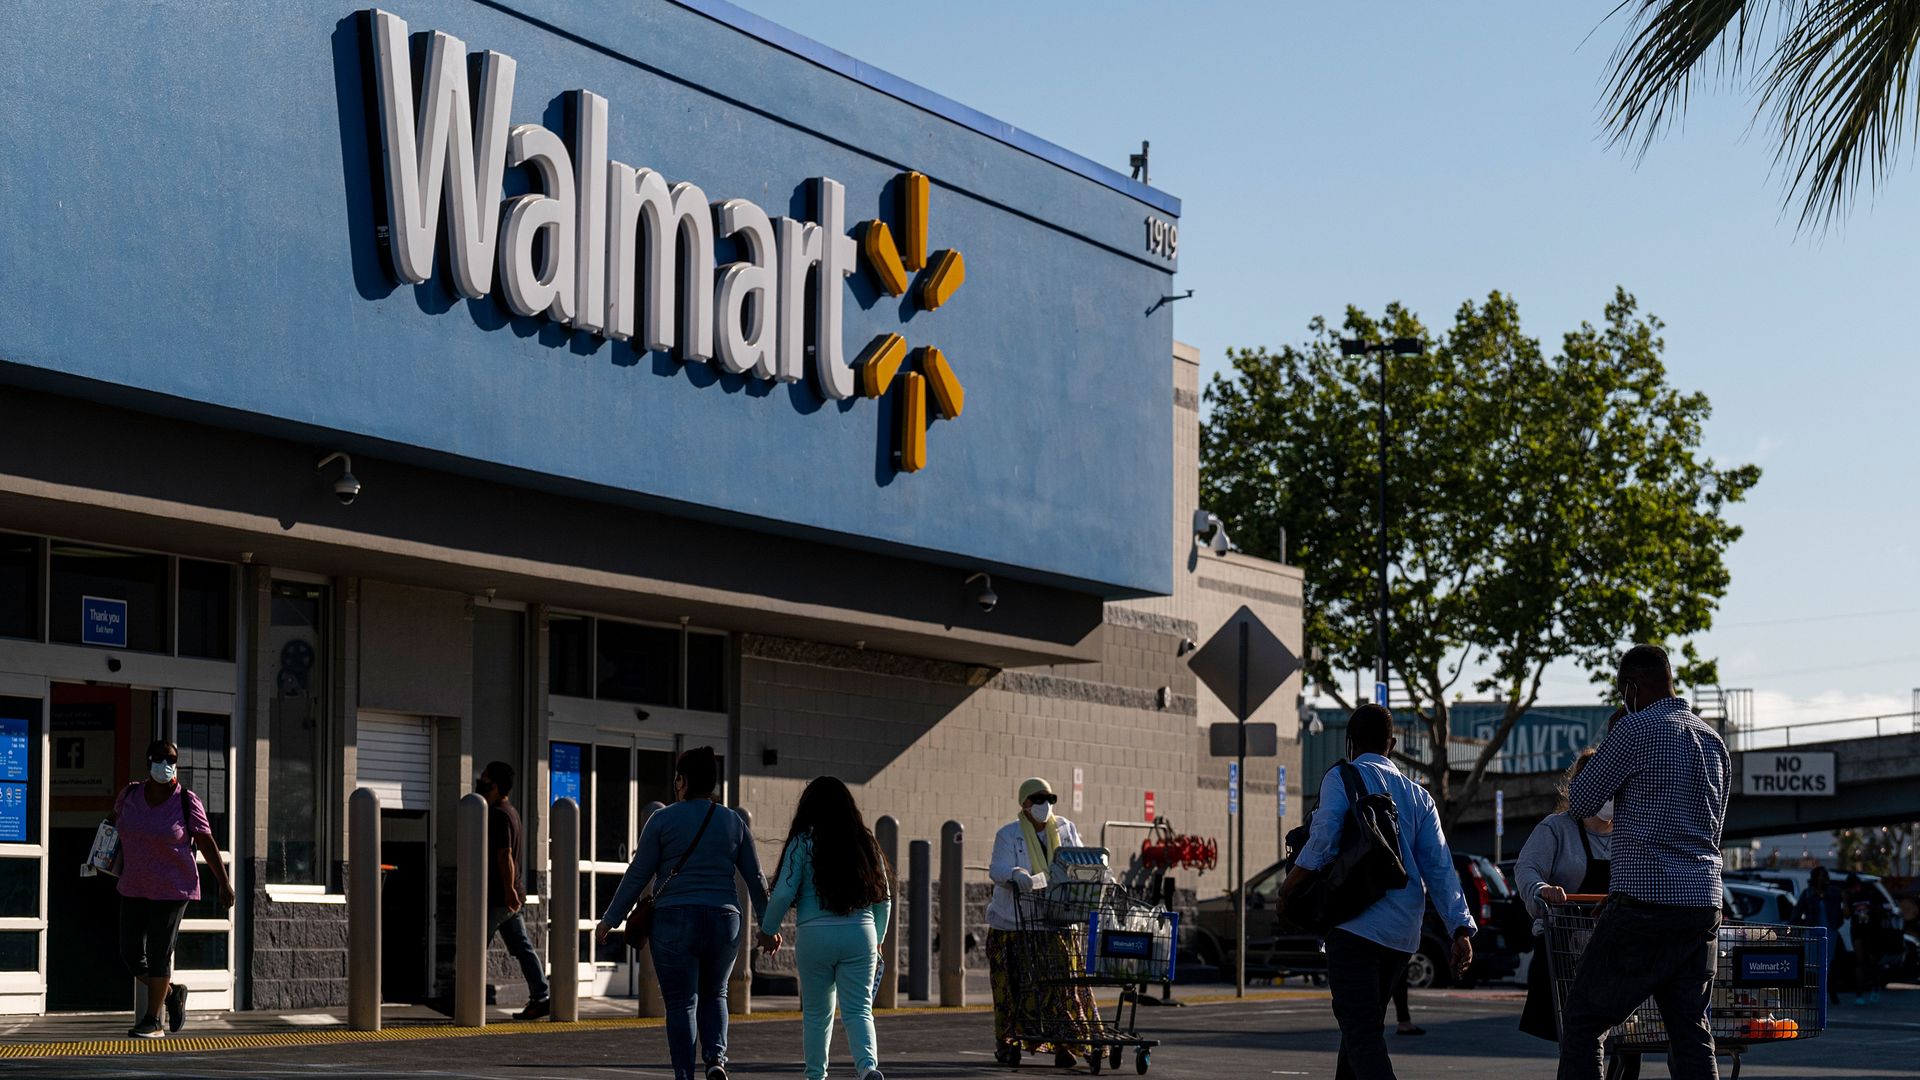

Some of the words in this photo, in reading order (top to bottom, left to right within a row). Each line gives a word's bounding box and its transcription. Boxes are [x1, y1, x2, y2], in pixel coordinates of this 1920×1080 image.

[369, 8, 858, 401] Walmart
[1145, 216, 1178, 260] 1919
[90, 608, 108, 622] Thank
[108, 613, 120, 625] you
[1776, 756, 1801, 773] NO
[1752, 775, 1826, 792] TRUCKS
[1112, 940, 1136, 948] Walmart
[1749, 962, 1780, 971] Walmart
